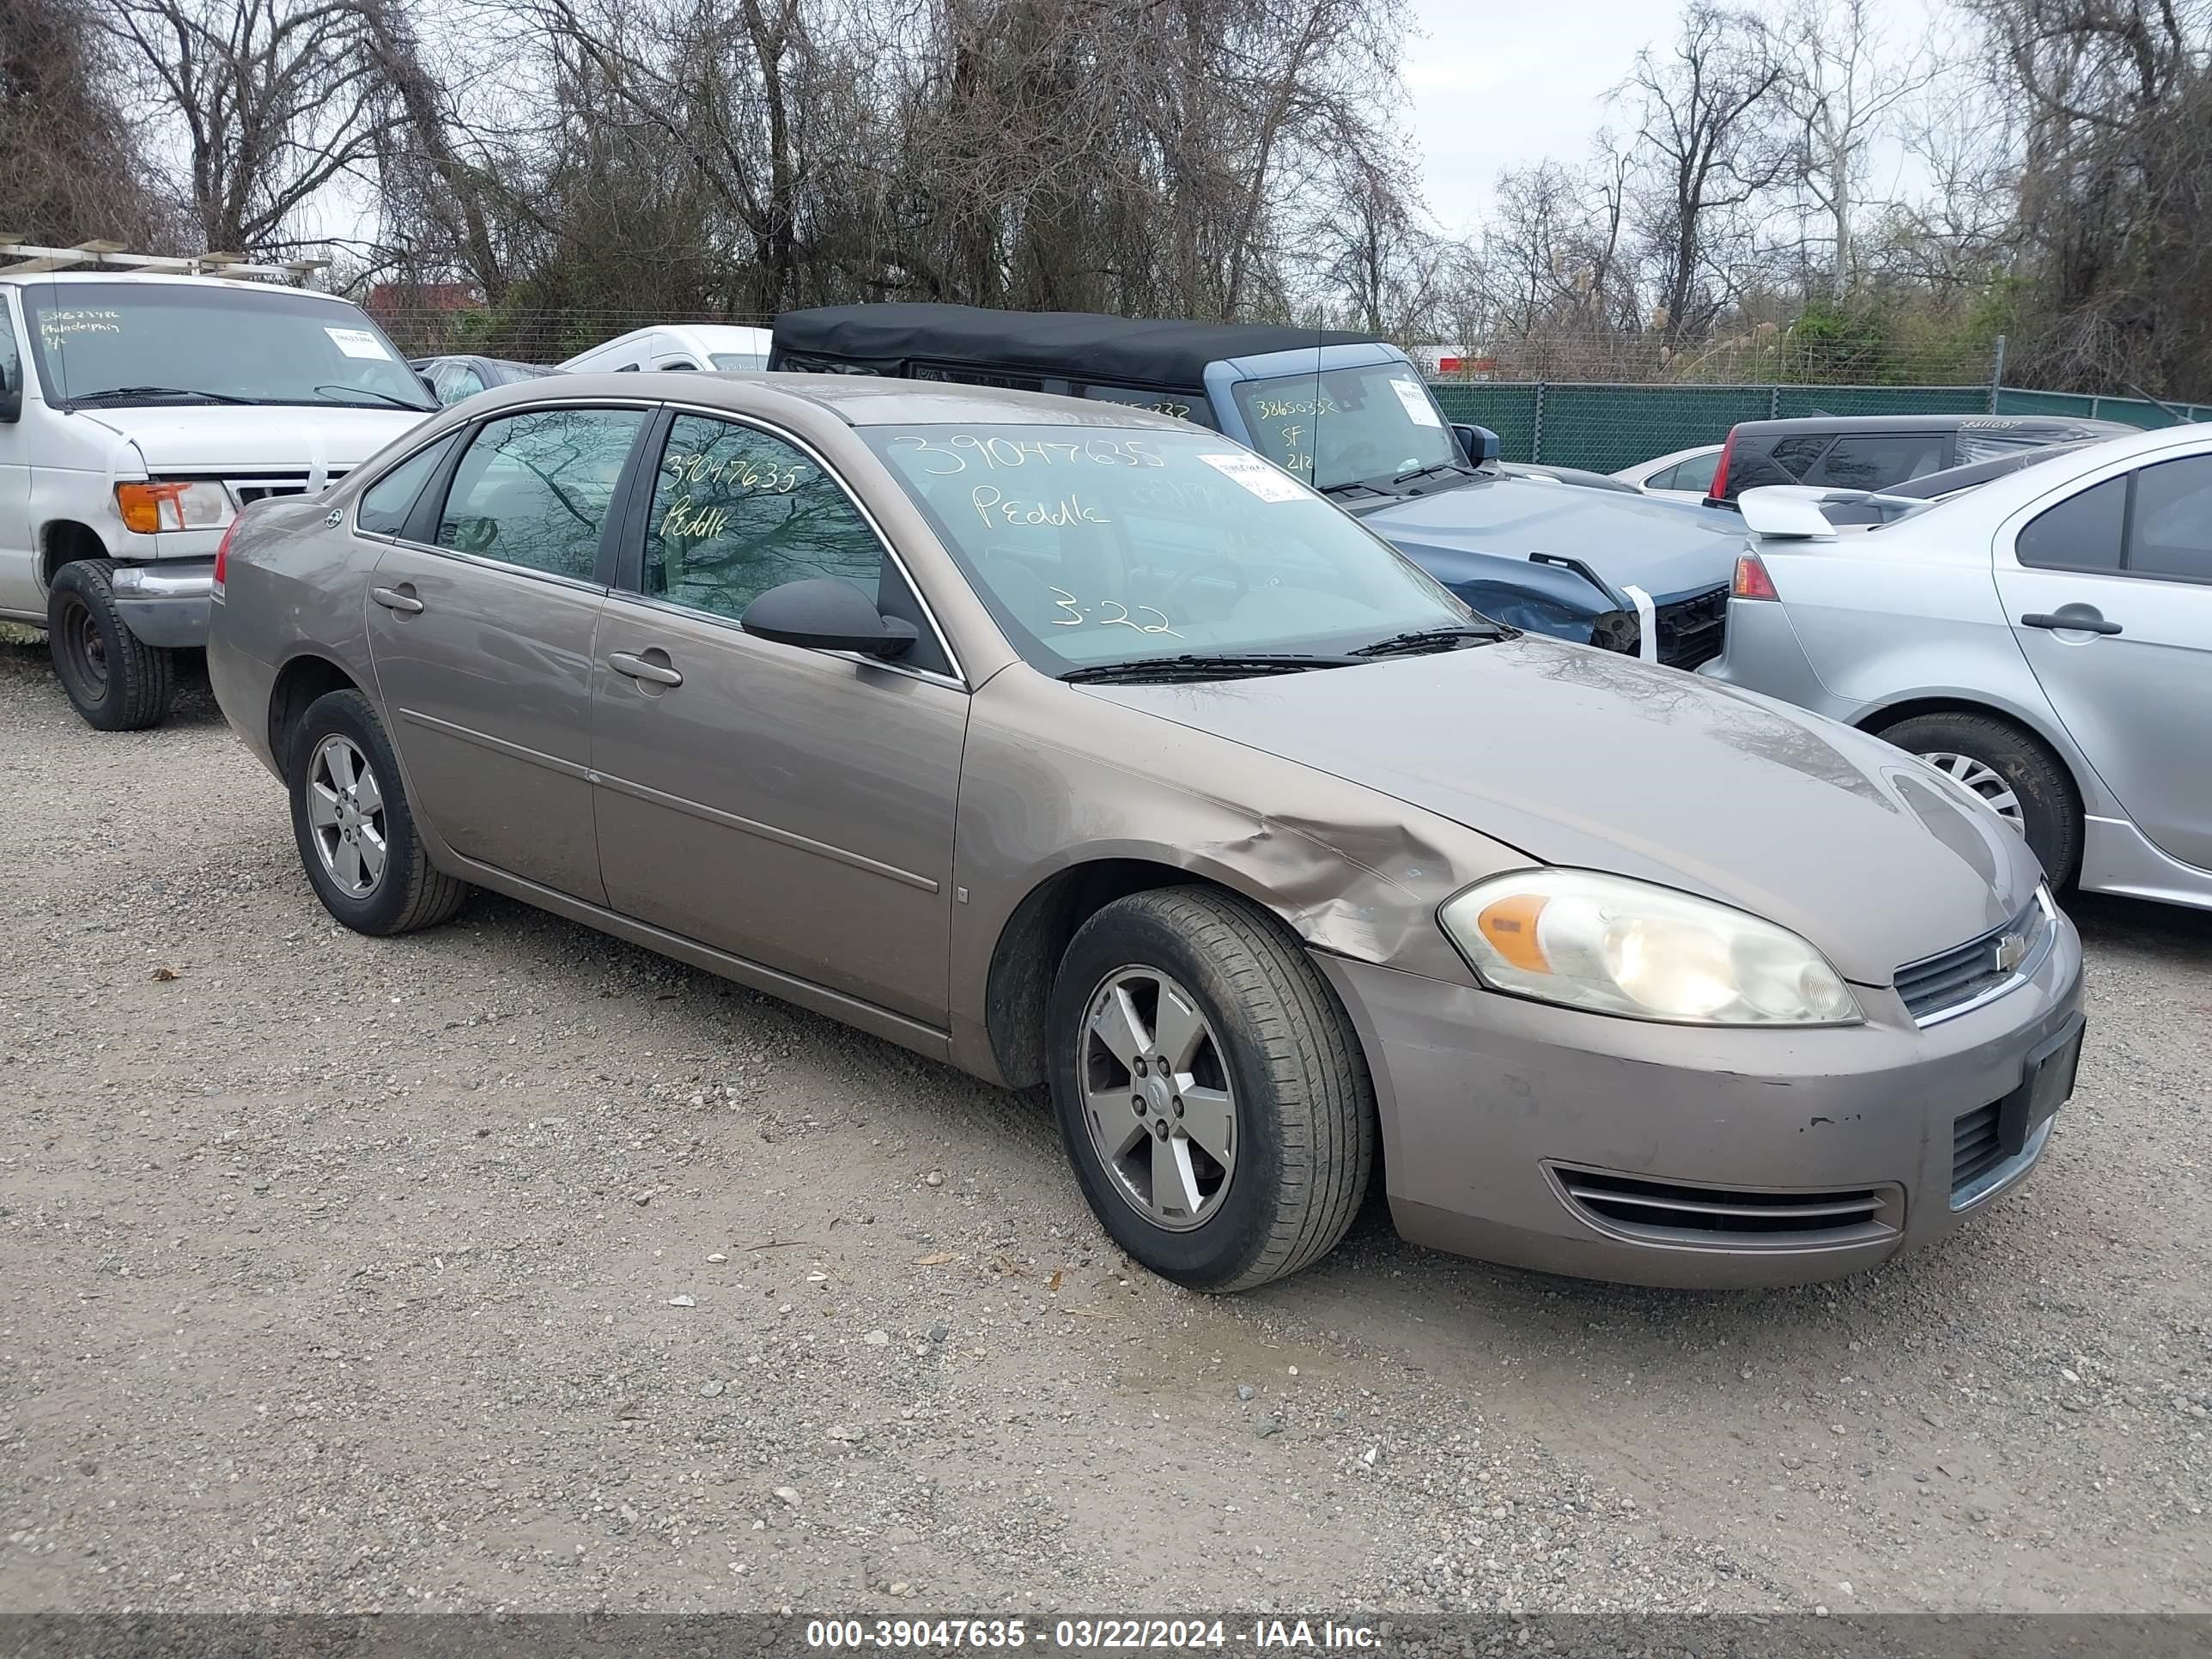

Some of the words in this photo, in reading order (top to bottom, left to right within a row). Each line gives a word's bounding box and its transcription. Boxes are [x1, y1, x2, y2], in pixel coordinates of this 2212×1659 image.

[1255, 398, 1340, 420] 38650332
[663, 453, 807, 493] 39047635
[894, 434, 1165, 475] 39047635
